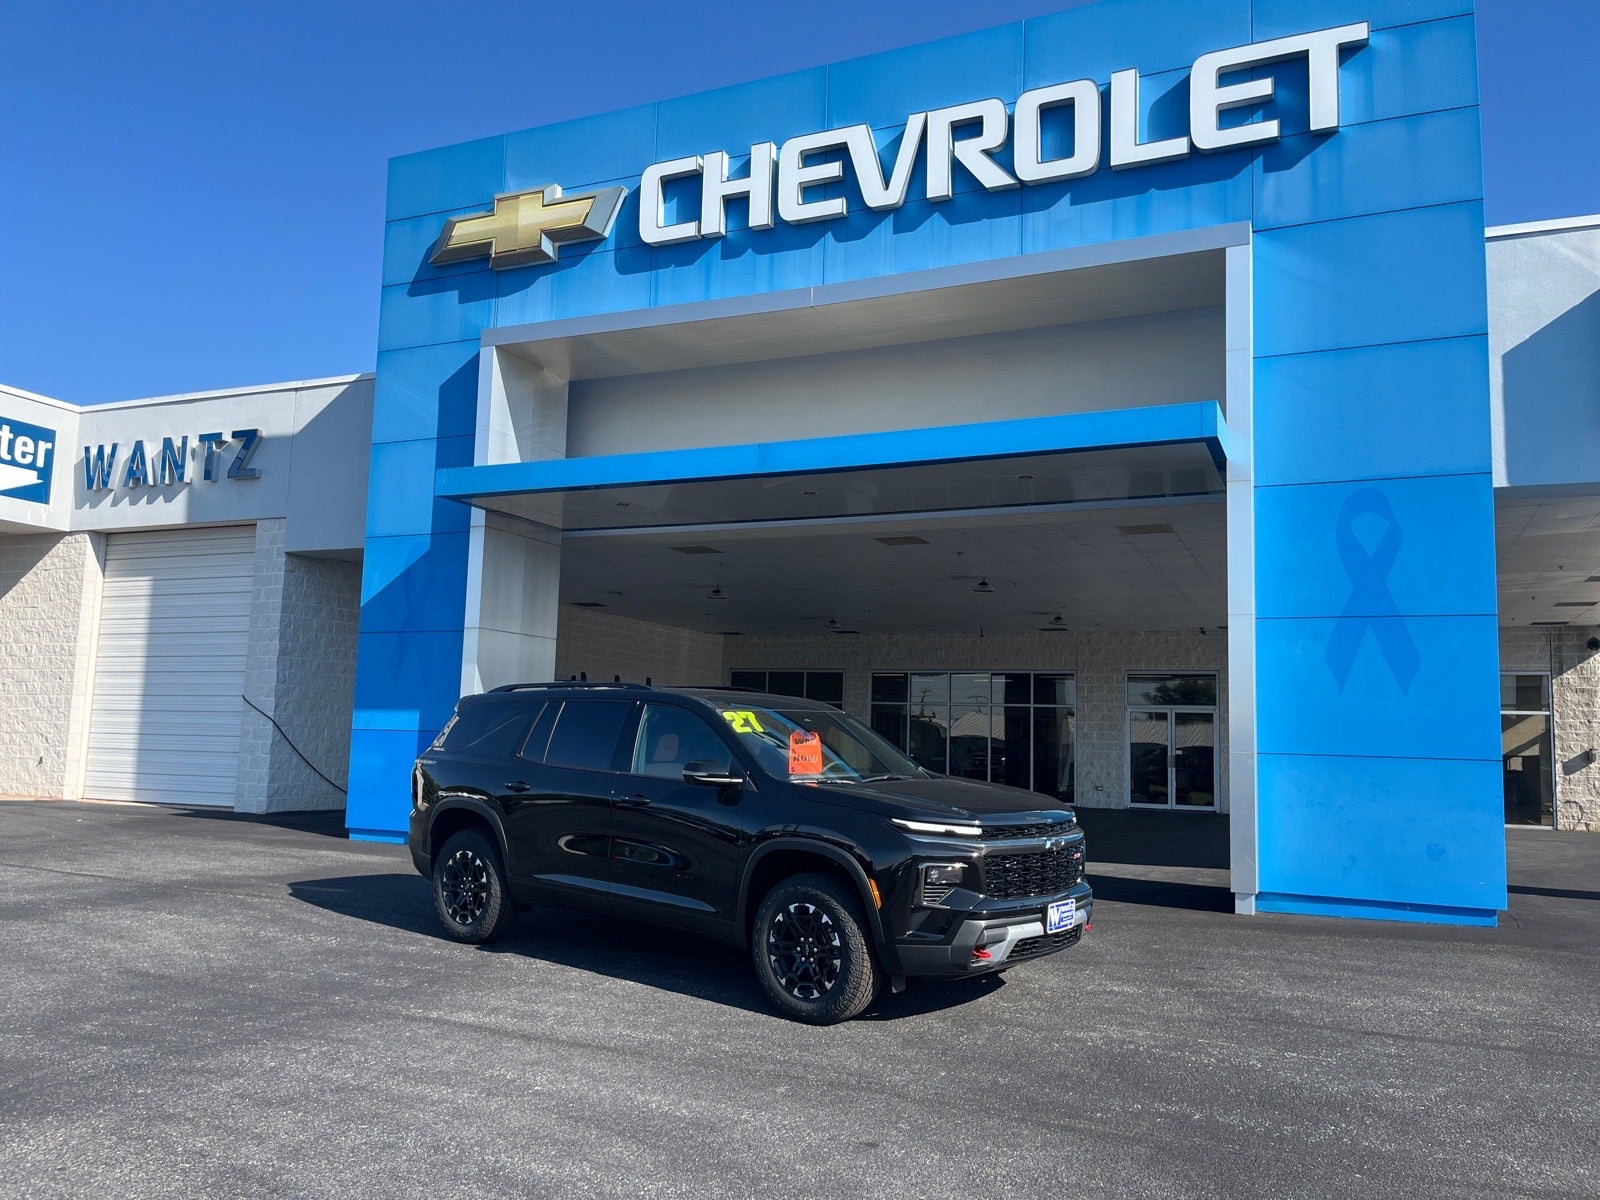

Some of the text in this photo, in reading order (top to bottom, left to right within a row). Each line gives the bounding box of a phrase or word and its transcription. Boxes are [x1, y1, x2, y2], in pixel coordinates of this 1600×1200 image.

[639, 21, 1370, 246] CHEVROLET
[84, 428, 261, 491] WANTZ
[722, 711, 765, 733] 27
